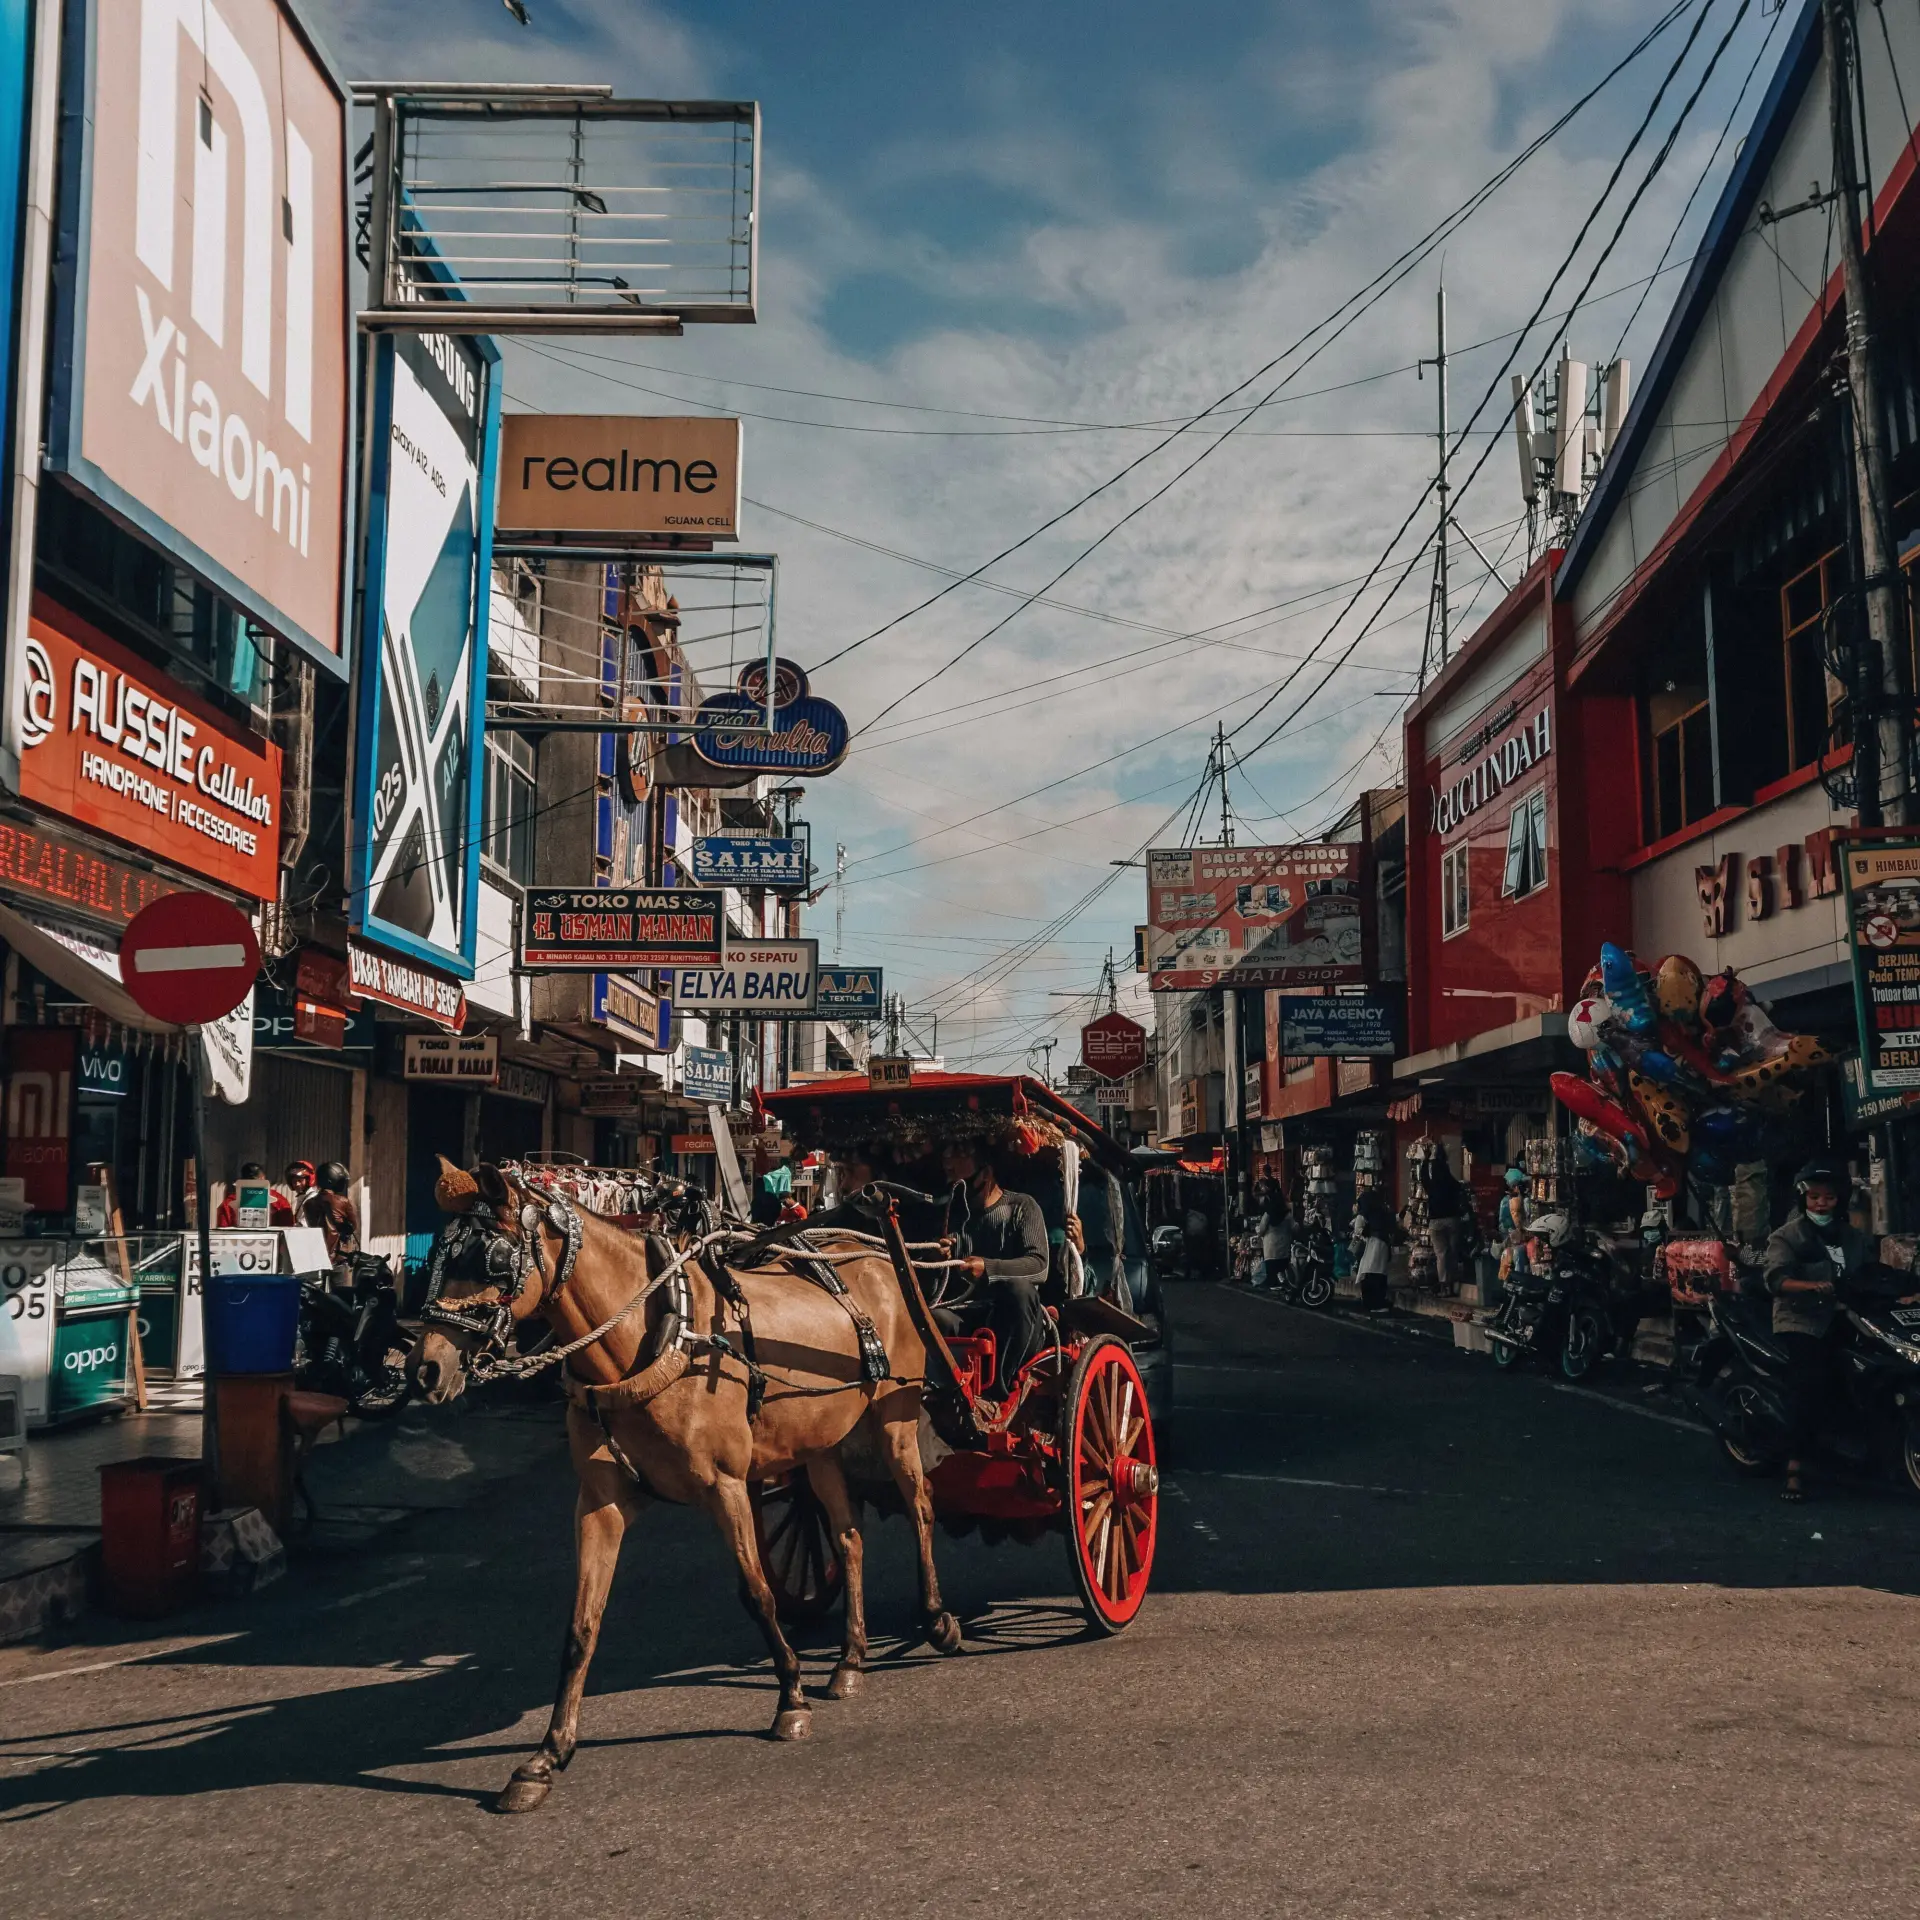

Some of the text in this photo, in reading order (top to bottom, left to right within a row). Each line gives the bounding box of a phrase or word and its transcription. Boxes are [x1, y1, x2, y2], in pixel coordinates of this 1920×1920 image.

[392, 424, 415, 464] alaxy
[415, 447, 428, 474] A12
[522, 449, 718, 494] realme
[664, 515, 731, 527] IGUANA CELL
[72, 657, 272, 826] AUSSIE Cellular
[443, 732, 460, 801] A12
[81, 750, 257, 857] HANDPHONE ACCESSORIES
[695, 850, 803, 869] SALMI
[1201, 848, 1349, 865] BACK TO SCHOOL
[1202, 862, 1349, 879] BACK TO KIKY
[570, 894, 680, 909] TOKO MAS
[533, 912, 715, 942] H. USMAN MANAN
[546, 953, 573, 961] MINANG
[728, 951, 798, 963] KO SEPATU
[1877, 954, 1920, 967] BERJUAL
[380, 958, 422, 1007] TAMBAH
[423, 974, 435, 1011] HP
[819, 974, 876, 994] AJA
[1200, 968, 1288, 984] SEHATI
[1297, 969, 1344, 981] SHOP
[1868, 968, 1920, 984] Pada TEMP
[680, 972, 810, 999] ELYA BARU
[1871, 984, 1918, 1003] Trotoar dan
[1291, 1008, 1384, 1020] JAYA AGENCY
[418, 1039, 486, 1050] TOKO MAS
[81, 1052, 121, 1082] vivo
[1879, 1051, 1920, 1068] BERJ
[685, 1060, 731, 1083] SALMI
[1098, 1089, 1129, 1098] MAMI
[1879, 1096, 1903, 1112] Meter
[144, 1274, 175, 1282] ARRIVAL
[64, 1344, 118, 1374] oppo
